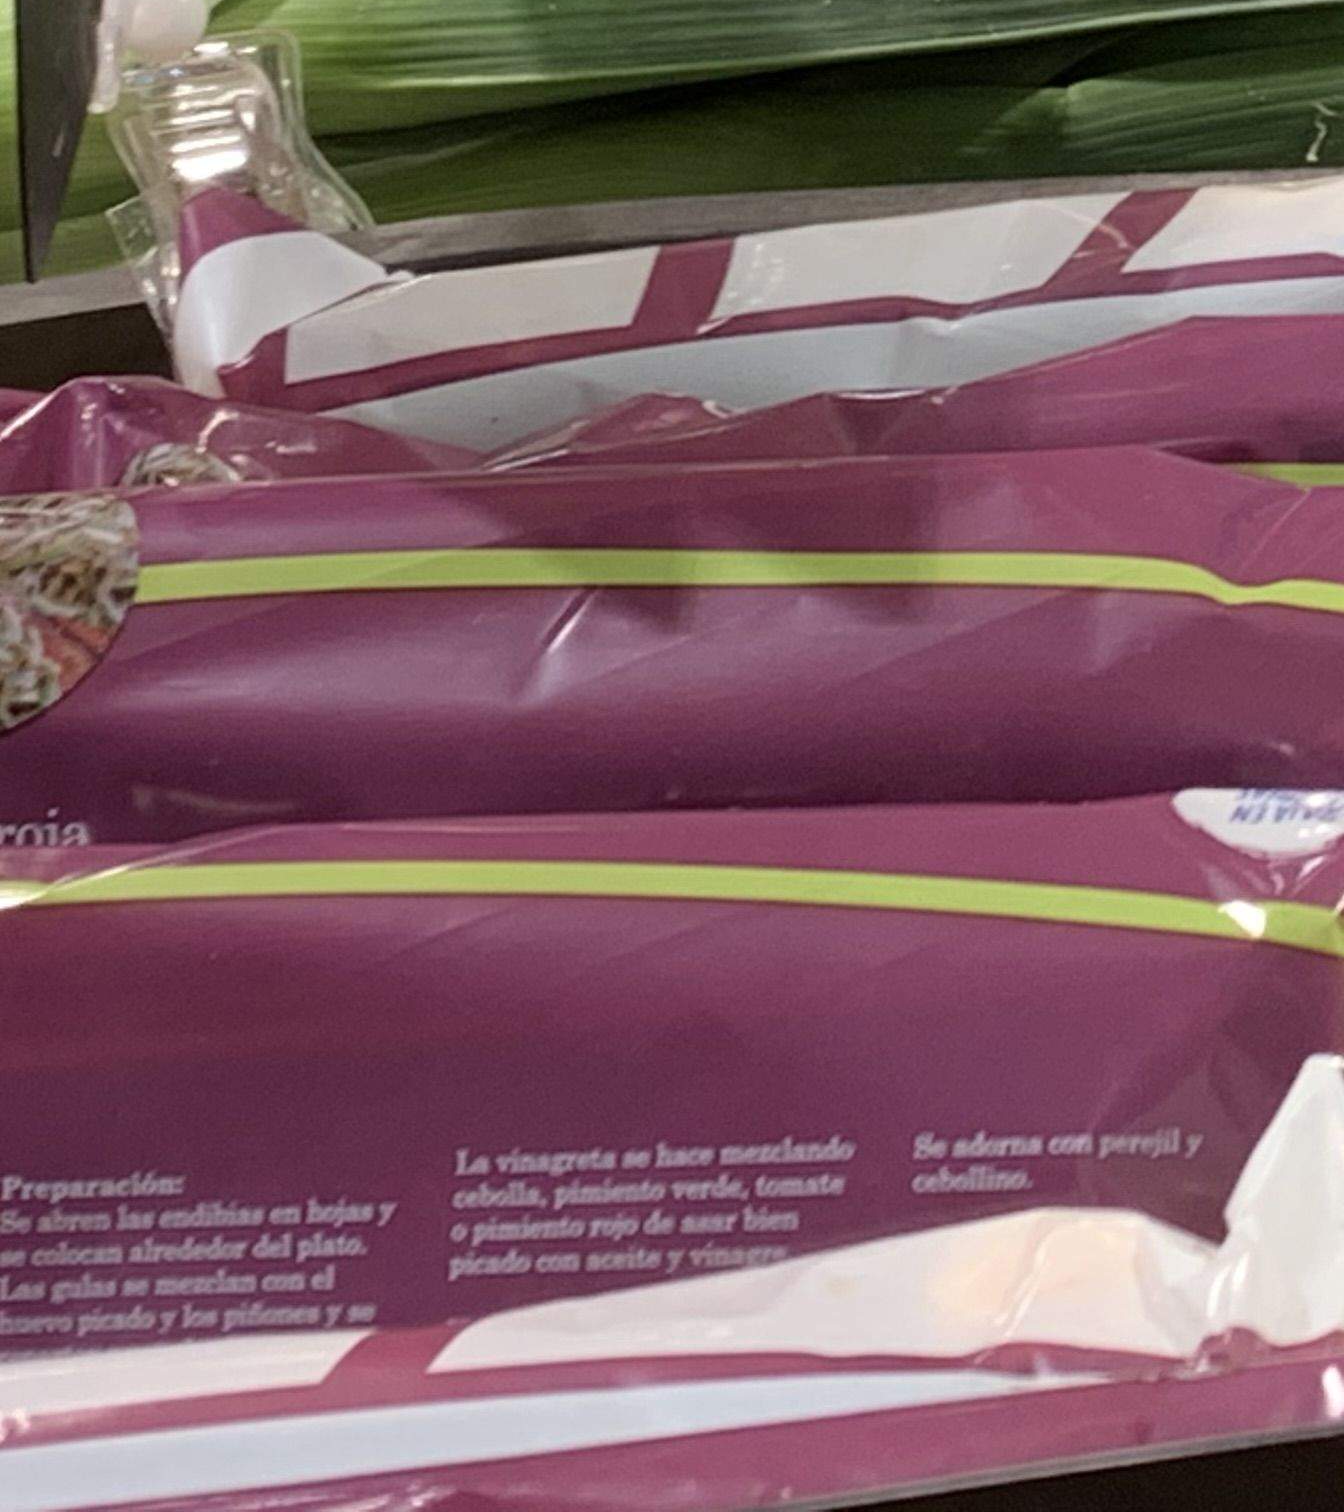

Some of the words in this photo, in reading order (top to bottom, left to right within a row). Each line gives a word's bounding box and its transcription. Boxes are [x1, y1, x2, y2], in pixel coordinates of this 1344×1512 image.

[455, 1148, 490, 1176] La
[496, 1146, 615, 1175] vinagreta
[621, 1148, 650, 1169] se
[655, 1141, 715, 1168] hace
[720, 1135, 857, 1165] mezclando
[912, 1130, 947, 1159] Se
[952, 1130, 1043, 1158] adorna
[1047, 1133, 1092, 1155] con
[1098, 1128, 1180, 1159] perejil
[1184, 1133, 1204, 1159] y
[554, 1177, 666, 1210] pimiento
[755, 1174, 845, 1197] tomate
[269, 1206, 300, 1225] en
[305, 1197, 374, 1228] hojas
[377, 1202, 399, 1227] y
[450, 1223, 468, 1242] o
[472, 1213, 586, 1247] pimiento
[589, 1212, 640, 1241] rojo
[642, 1209, 676, 1235] de
[742, 1203, 799, 1232] bien
[31, 1241, 123, 1267] colocan
[128, 1235, 248, 1263] alrededor
[253, 1233, 291, 1259] del
[448, 1247, 532, 1281] picado
[536, 1252, 581, 1273] con
[586, 1245, 661, 1272] aceite
[665, 1250, 687, 1274] y
[261, 1273, 305, 1292] con
[310, 1264, 335, 1290] el
[158, 1310, 179, 1334] y
[182, 1303, 218, 1328] los
[324, 1305, 344, 1328] y
